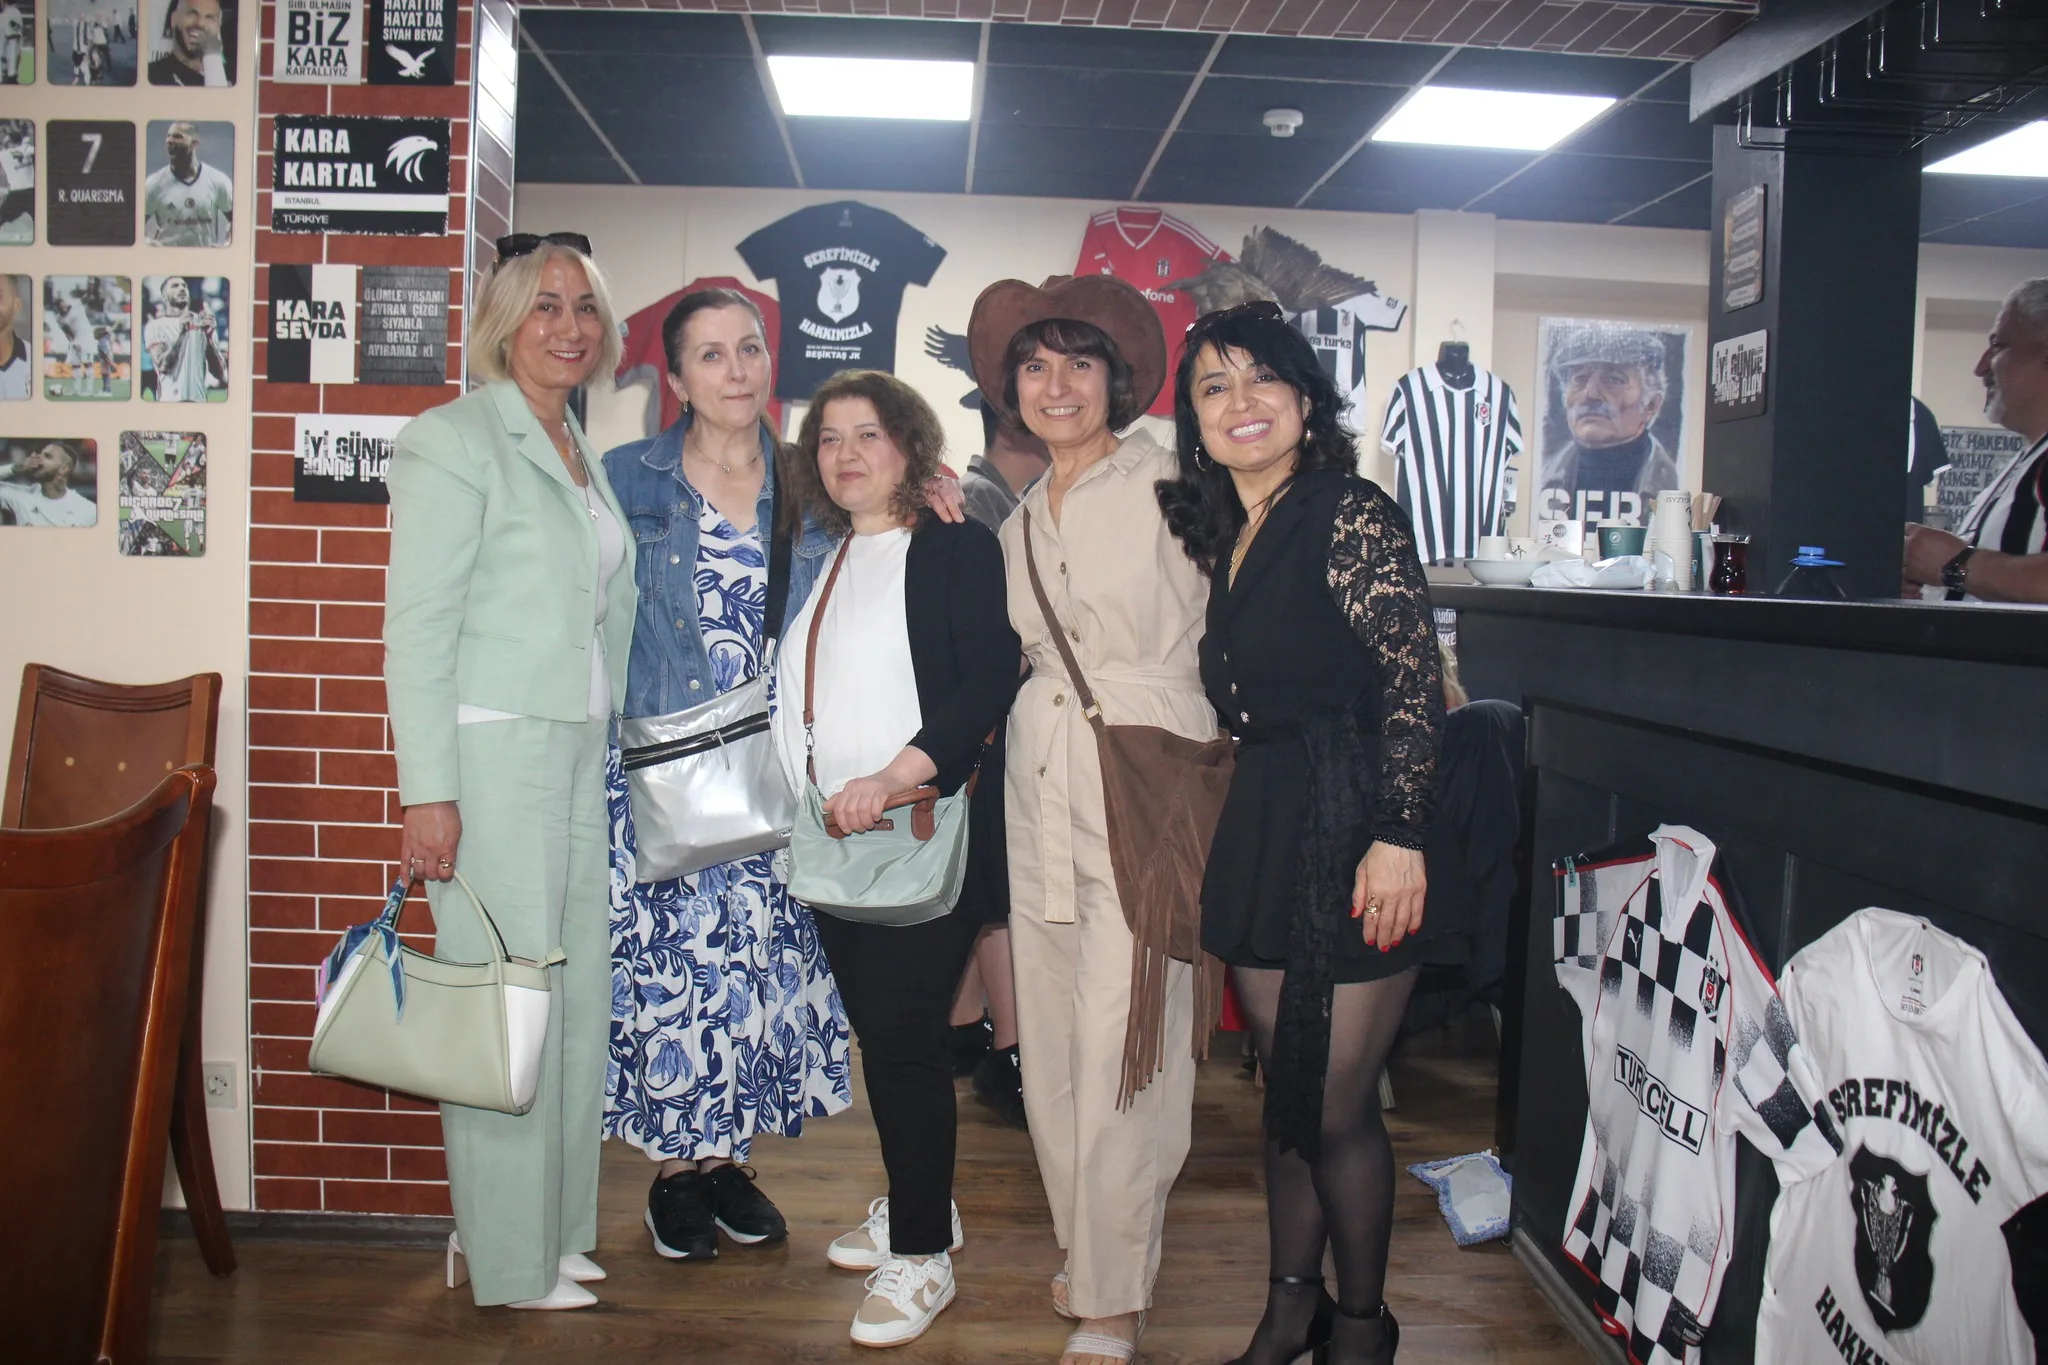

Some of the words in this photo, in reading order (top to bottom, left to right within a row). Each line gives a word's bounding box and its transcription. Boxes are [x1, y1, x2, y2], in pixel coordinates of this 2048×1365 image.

[383, 11, 423, 27] HAYAT
[426, 12, 443, 28] DA
[414, 28, 443, 42] BEYAZ
[287, 47, 348, 67] KARA
[285, 128, 350, 154] KARA
[81, 133, 102, 174] 7
[284, 162, 376, 188] KARTAL
[58, 188, 68, 202] R.
[70, 188, 124, 203] QUARESMA
[283, 213, 329, 224] TÜRKİYE
[1141, 288, 1175, 303] fone
[276, 299, 346, 320] KARA
[371, 303, 407, 316] AYIRAN
[276, 320, 347, 339] SEVDA
[799, 318, 872, 341] HAKKIMIZLA
[1308, 335, 1321, 346] ola
[1324, 335, 1352, 349] turka
[368, 344, 417, 357] AYIRAMAZ
[805, 350, 847, 360] BEŞİKTAŞ
[848, 351, 861, 359] JK
